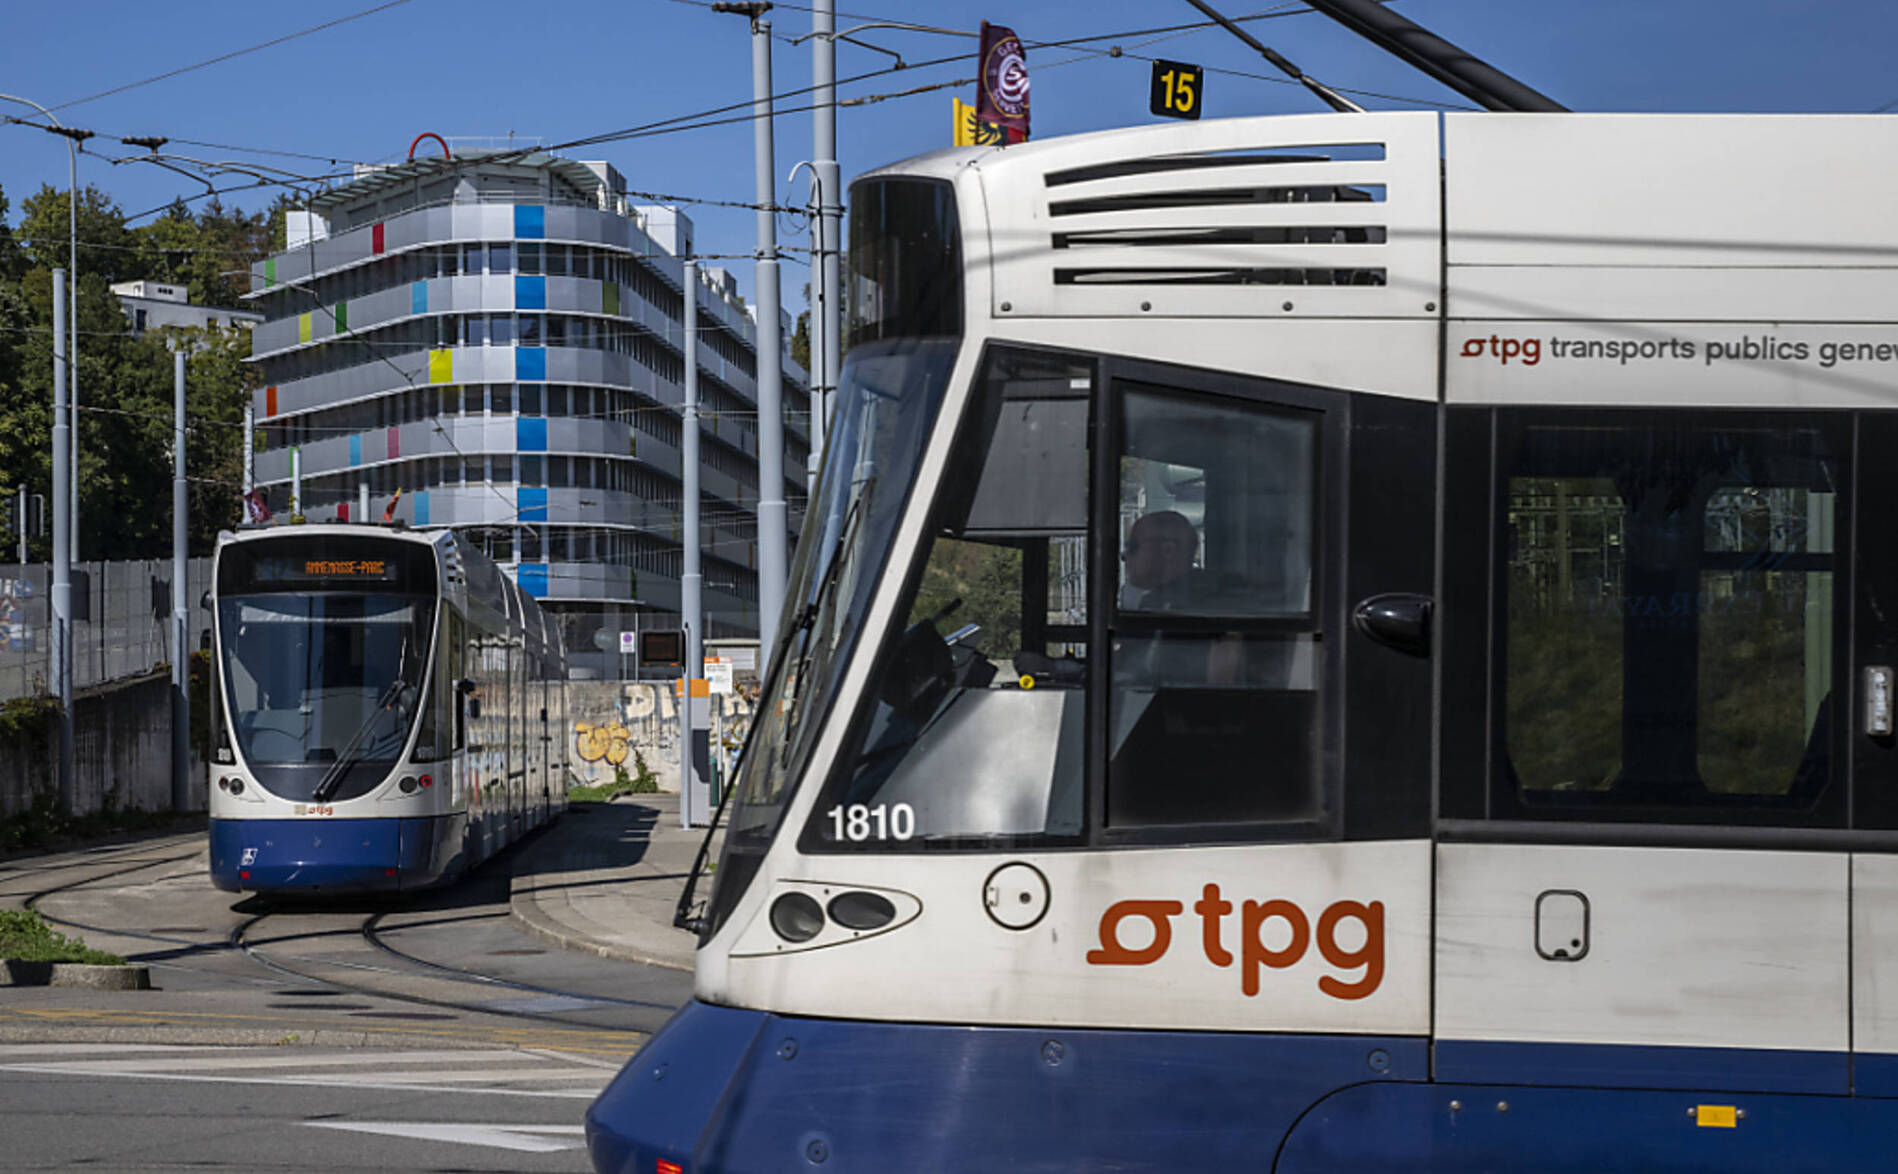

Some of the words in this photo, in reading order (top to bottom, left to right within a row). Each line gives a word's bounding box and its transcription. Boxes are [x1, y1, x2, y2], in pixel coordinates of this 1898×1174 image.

[1160, 69, 1195, 112] 15
[1550, 337, 1696, 365] transports
[1705, 336, 1809, 366] publics
[827, 803, 915, 842] 1810
